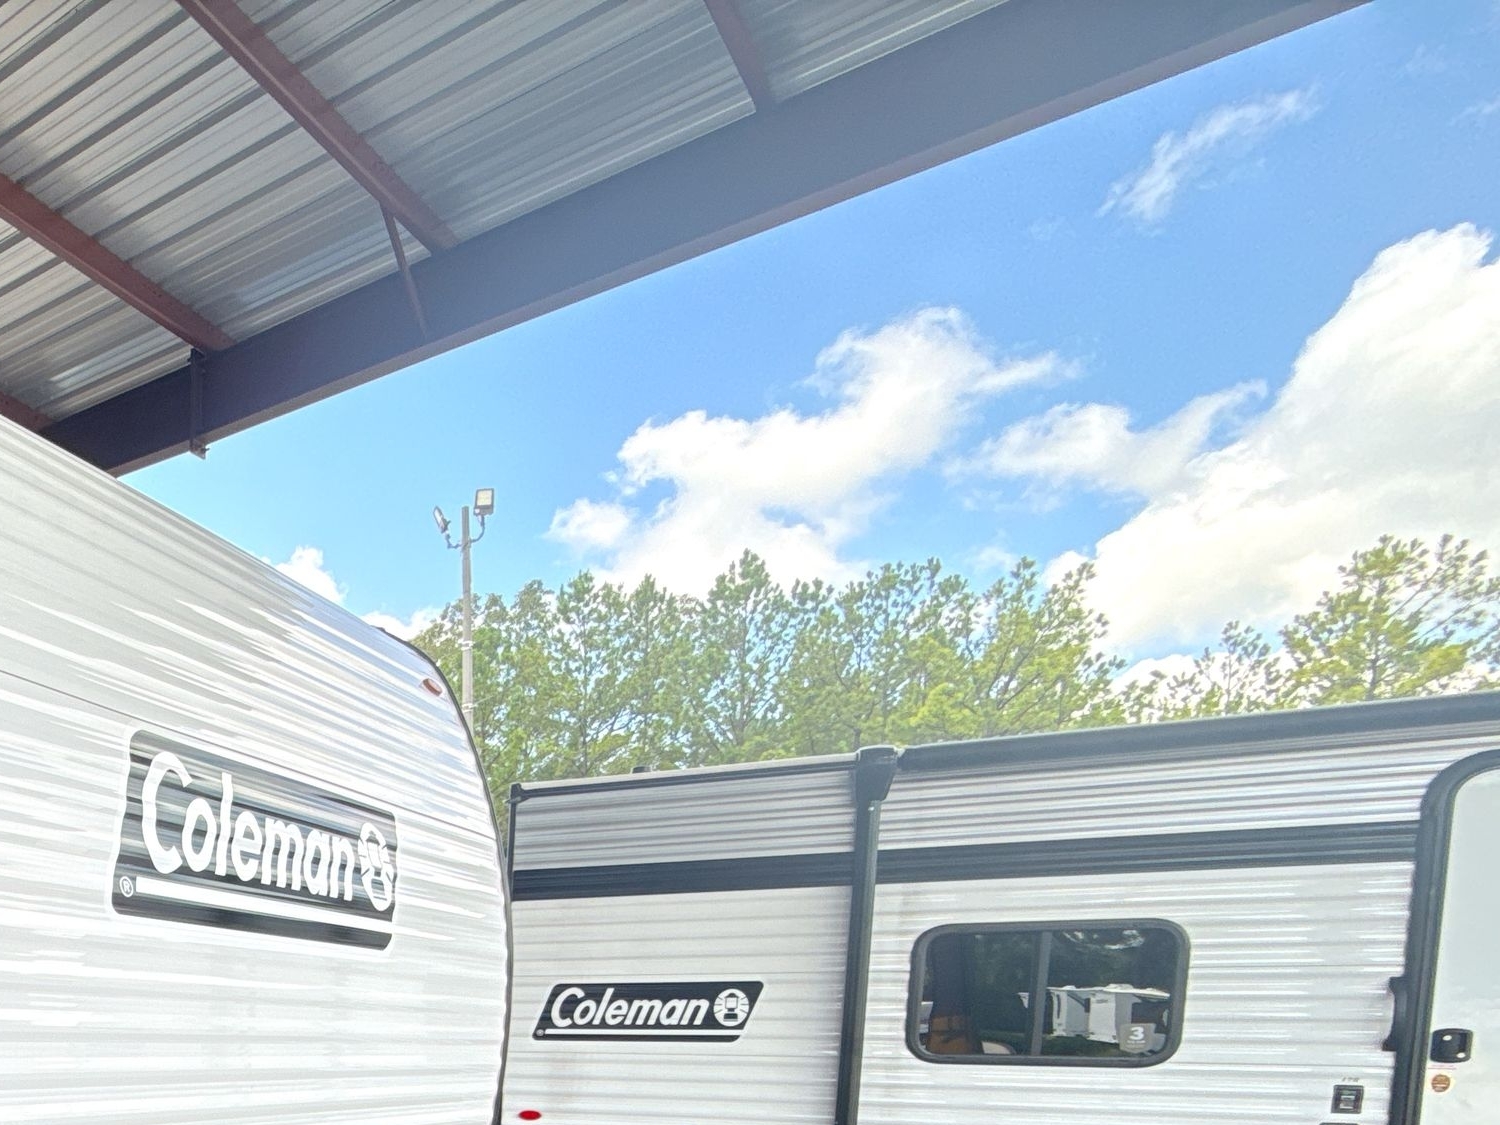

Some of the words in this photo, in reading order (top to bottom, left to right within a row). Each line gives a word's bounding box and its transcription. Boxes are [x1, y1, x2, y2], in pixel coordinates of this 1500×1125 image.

[142, 751, 355, 901] Coleman
[551, 987, 710, 1028] Coleman
[1129, 1026, 1145, 1040] 3
